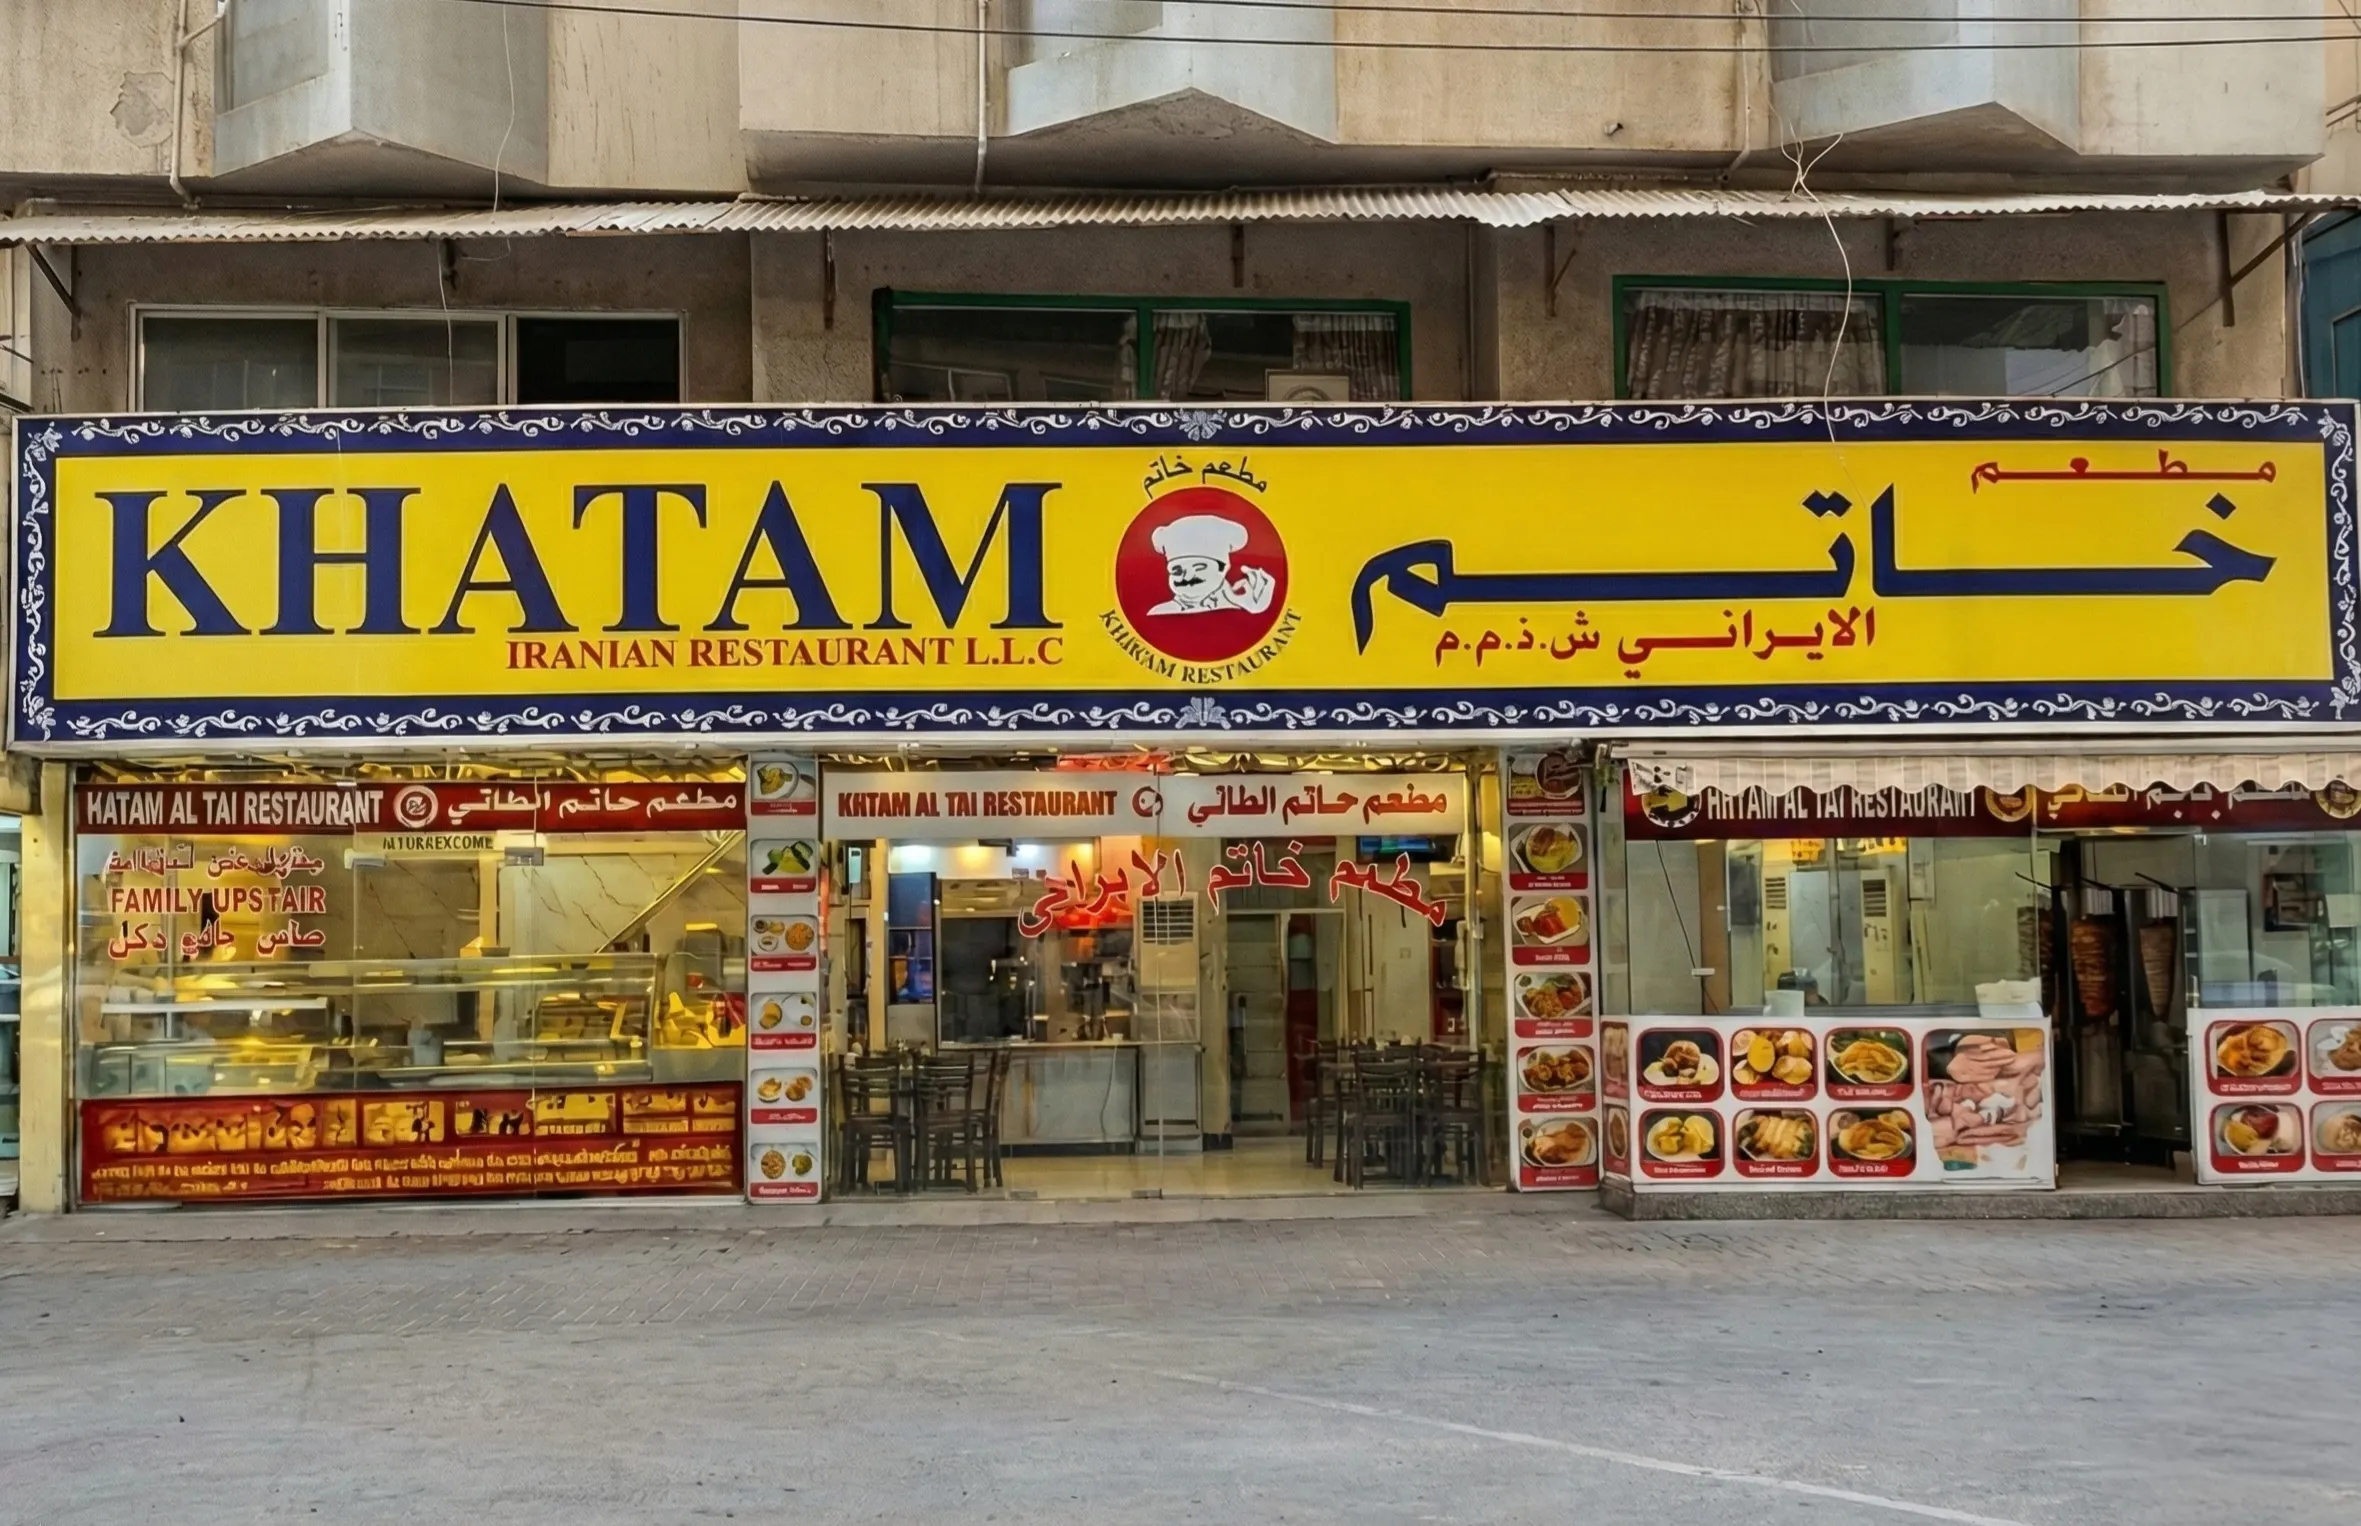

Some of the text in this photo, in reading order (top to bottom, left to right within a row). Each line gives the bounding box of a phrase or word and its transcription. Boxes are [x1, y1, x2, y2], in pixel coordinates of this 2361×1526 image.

[1143, 455, 1268, 499] مطعم خاتم
[1970, 449, 2277, 494] مطعم
[93, 480, 1063, 637] KHATAM
[1351, 483, 2278, 656] خاتم
[505, 636, 1064, 670] IRANIAN RESTAURANT L.L.C
[1181, 608, 1302, 684] RESTAURANT
[168, 791, 198, 824] AL
[202, 790, 238, 825] TAI
[243, 790, 384, 826] RESTAURANT
[558, 788, 641, 819] حاتم
[646, 788, 738, 819] مطعم
[915, 792, 940, 817] AL
[945, 792, 978, 817] TAI
[983, 791, 1118, 816] RESTAURANT
[111, 887, 204, 914] FAMILY
